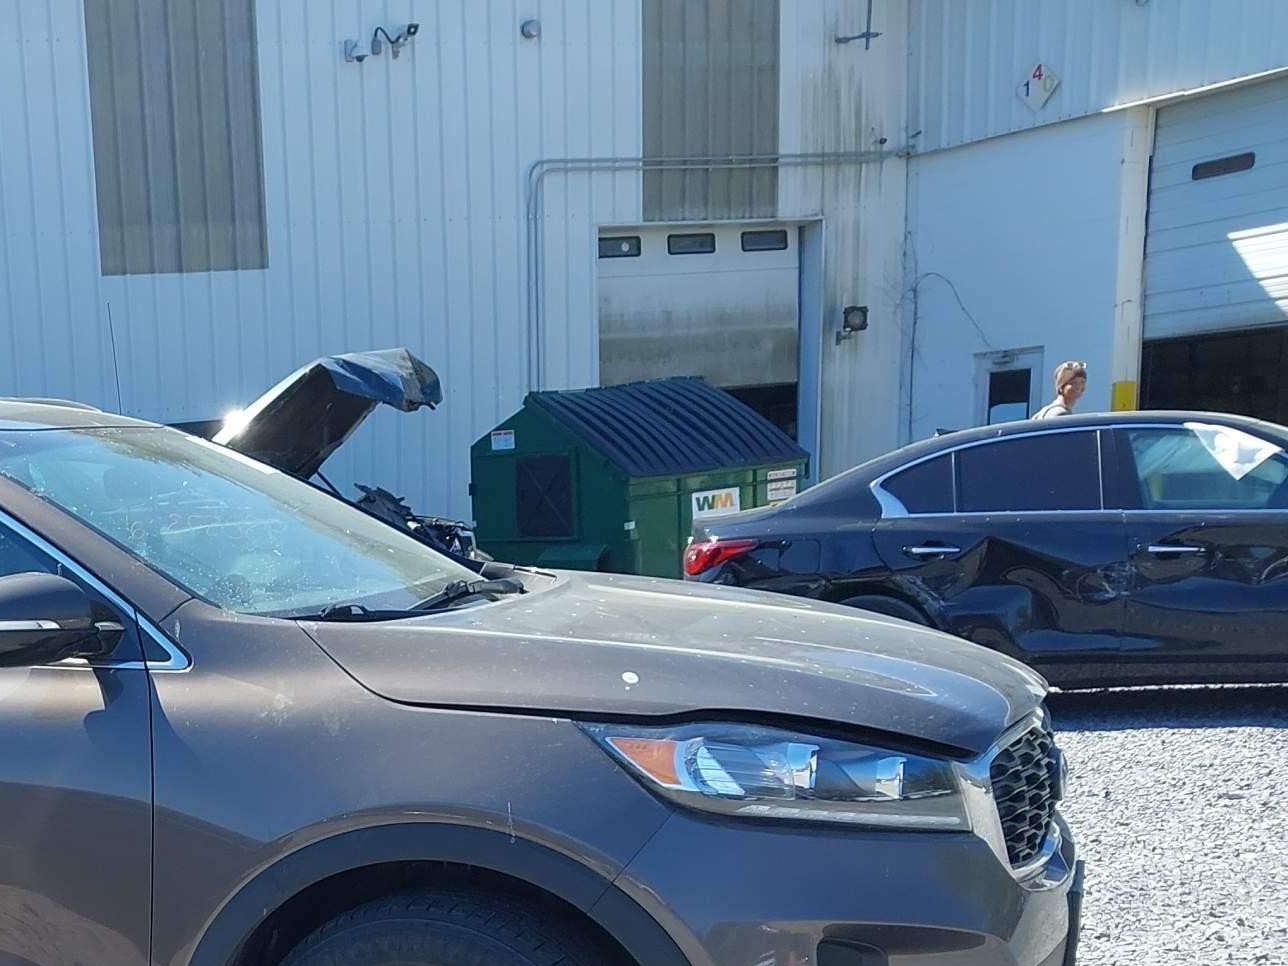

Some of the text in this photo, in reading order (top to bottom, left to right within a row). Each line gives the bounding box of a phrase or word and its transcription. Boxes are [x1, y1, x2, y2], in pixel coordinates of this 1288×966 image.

[1032, 63, 1043, 80] 4
[1023, 79, 1030, 97] 1
[695, 492, 735, 511] WM
